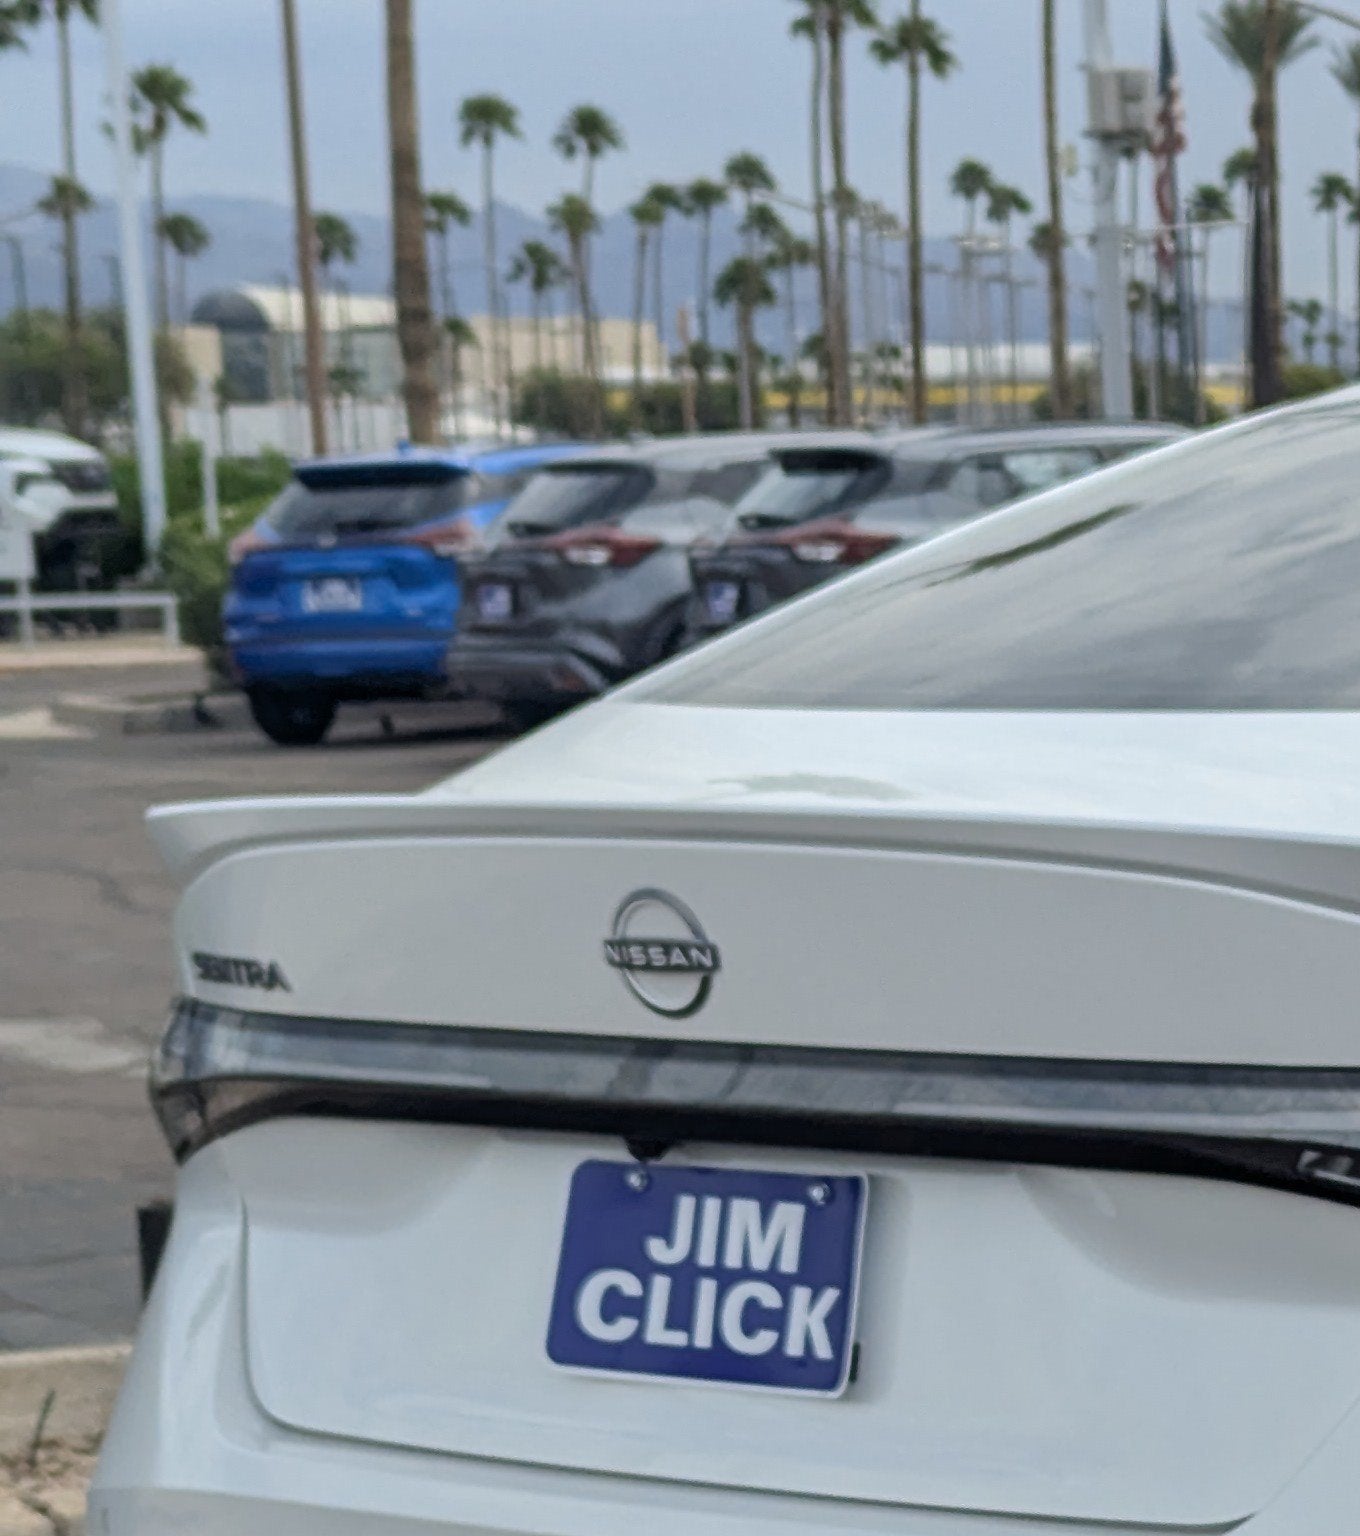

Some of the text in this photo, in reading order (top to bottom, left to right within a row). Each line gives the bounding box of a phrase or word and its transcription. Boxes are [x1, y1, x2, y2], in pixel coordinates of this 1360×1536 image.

[603, 943, 714, 968] NISSAN
[645, 1194, 806, 1275] JIM
[575, 1268, 841, 1361] CLICK
